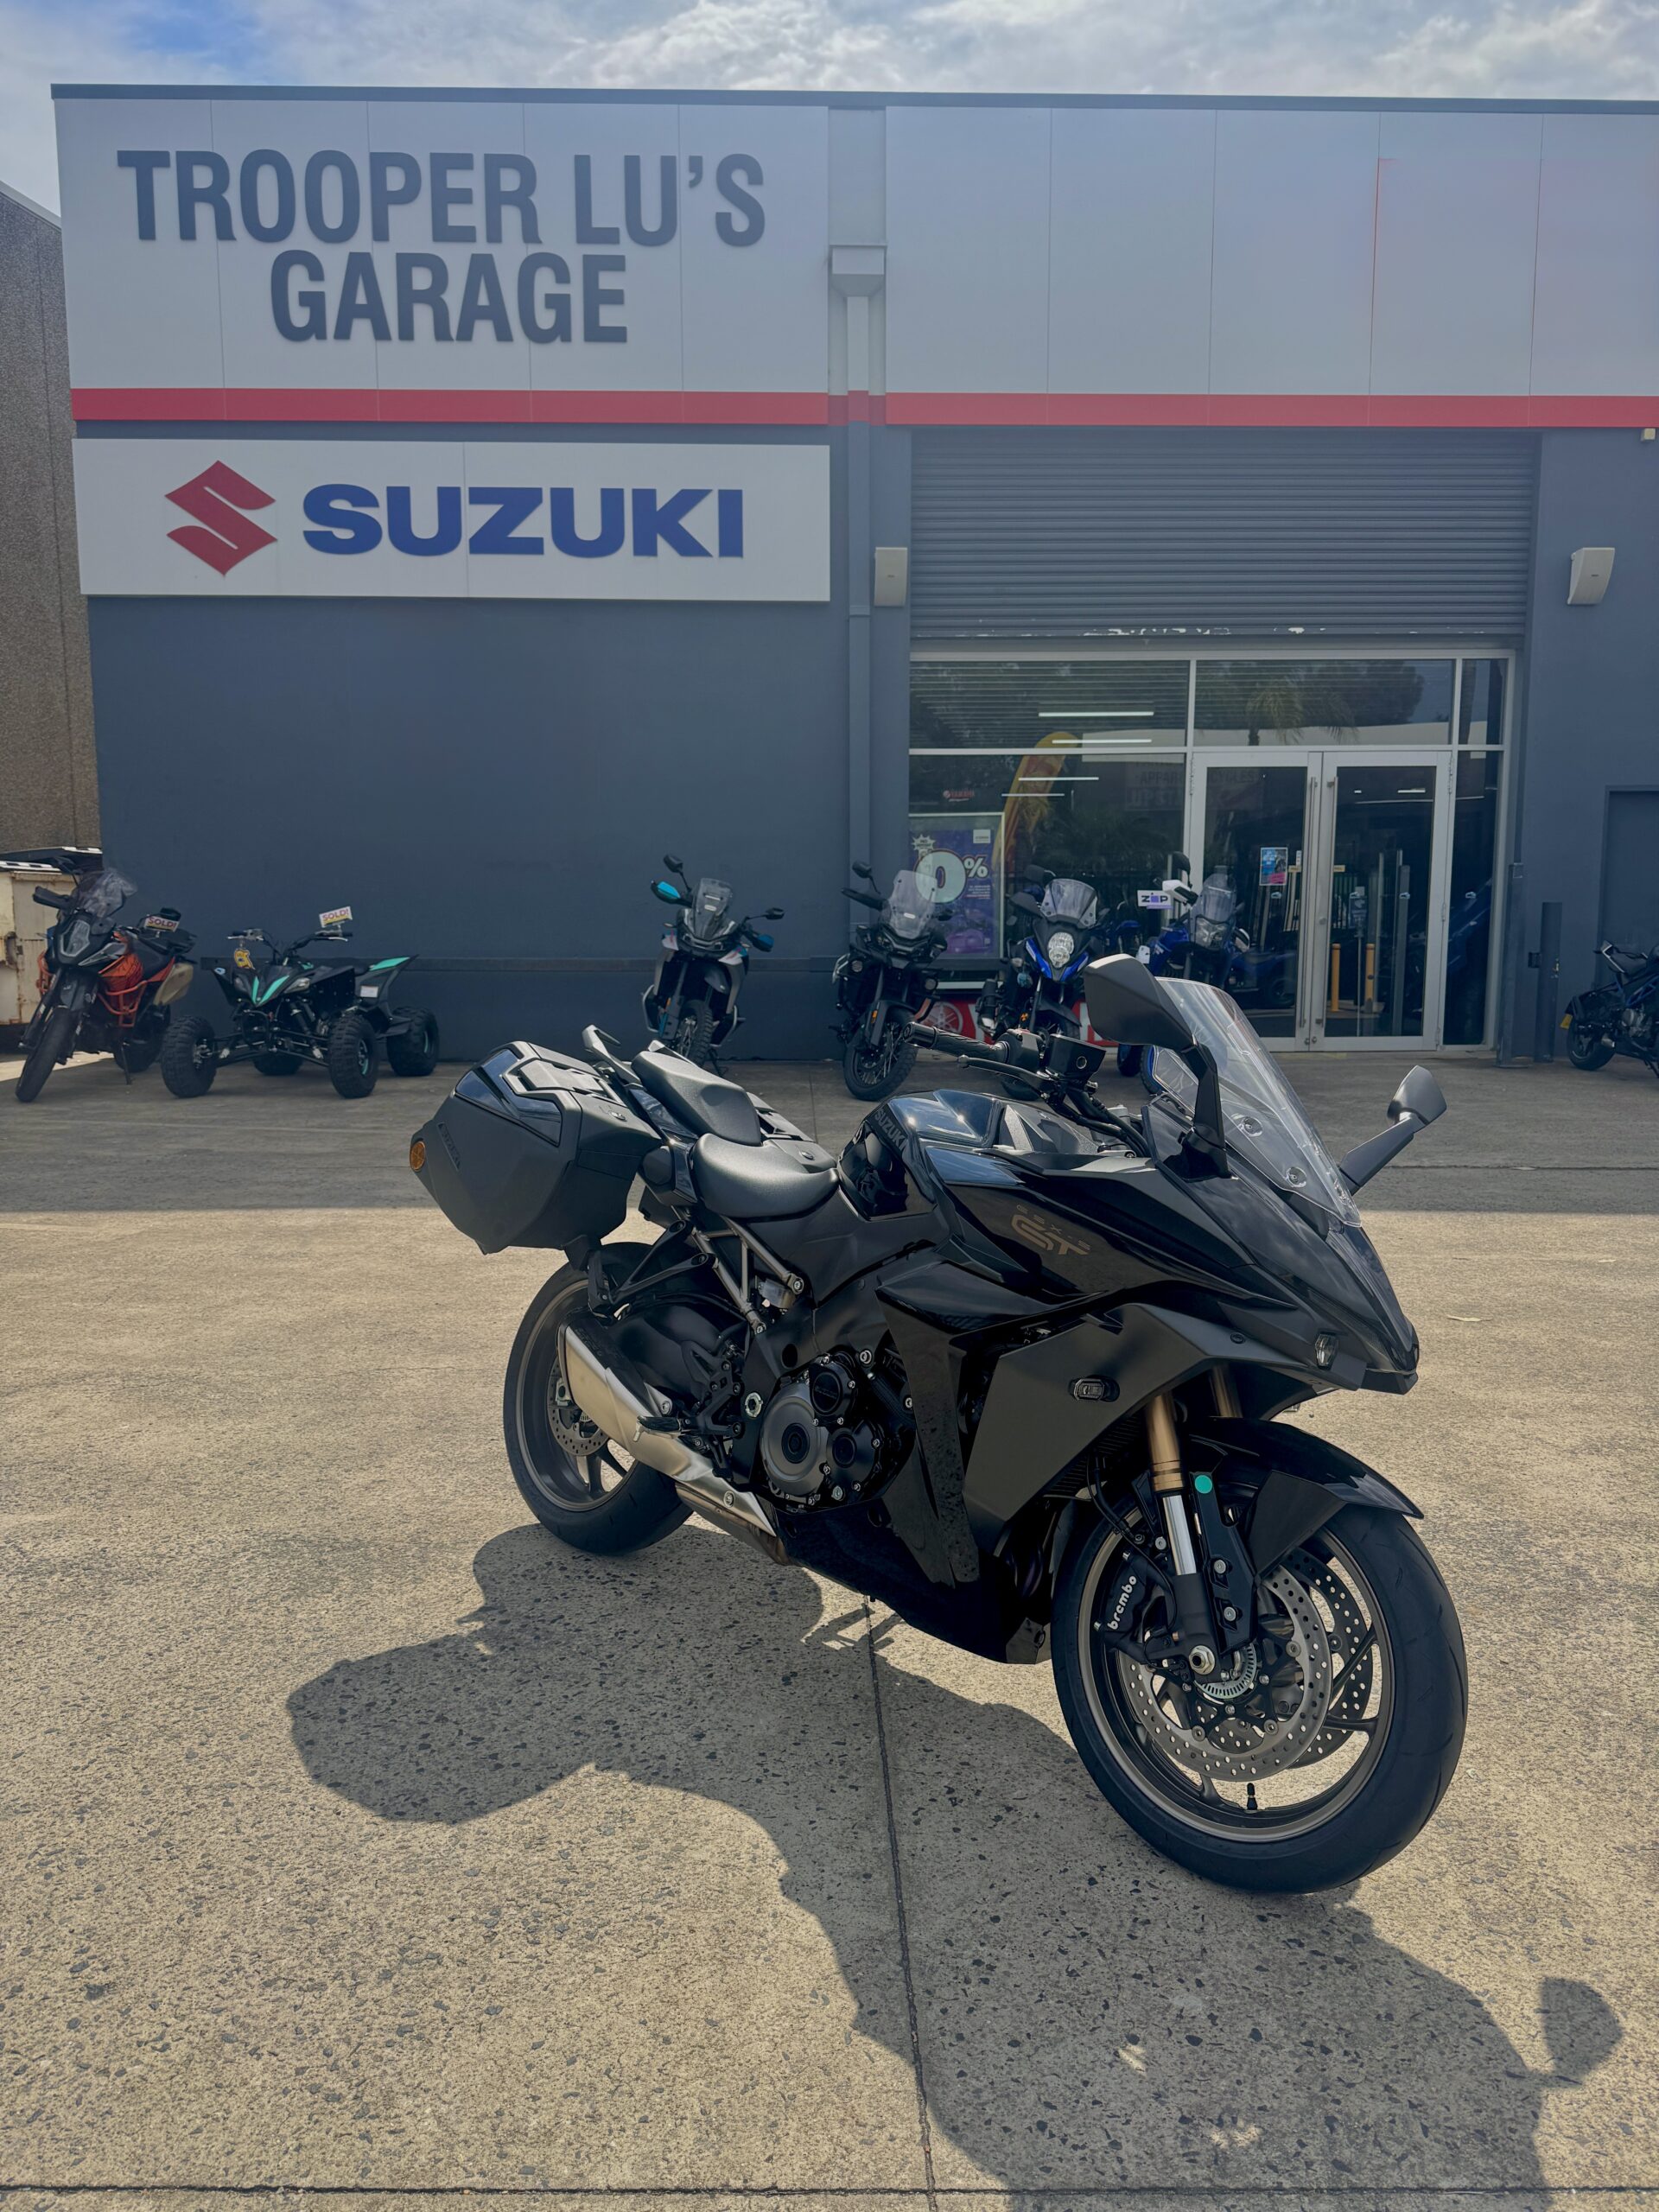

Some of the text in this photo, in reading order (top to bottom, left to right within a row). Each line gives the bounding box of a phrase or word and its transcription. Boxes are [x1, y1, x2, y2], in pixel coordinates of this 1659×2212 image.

[117, 149, 766, 248] TROOPER LU'S
[270, 249, 628, 345] GARAGE
[302, 483, 745, 558] SUZUKI
[148, 915, 177, 928] SOLD!
[322, 909, 349, 922] SOLD!
[874, 1107, 908, 1151] SUZUKI
[1107, 1574, 1138, 1630] brembo
